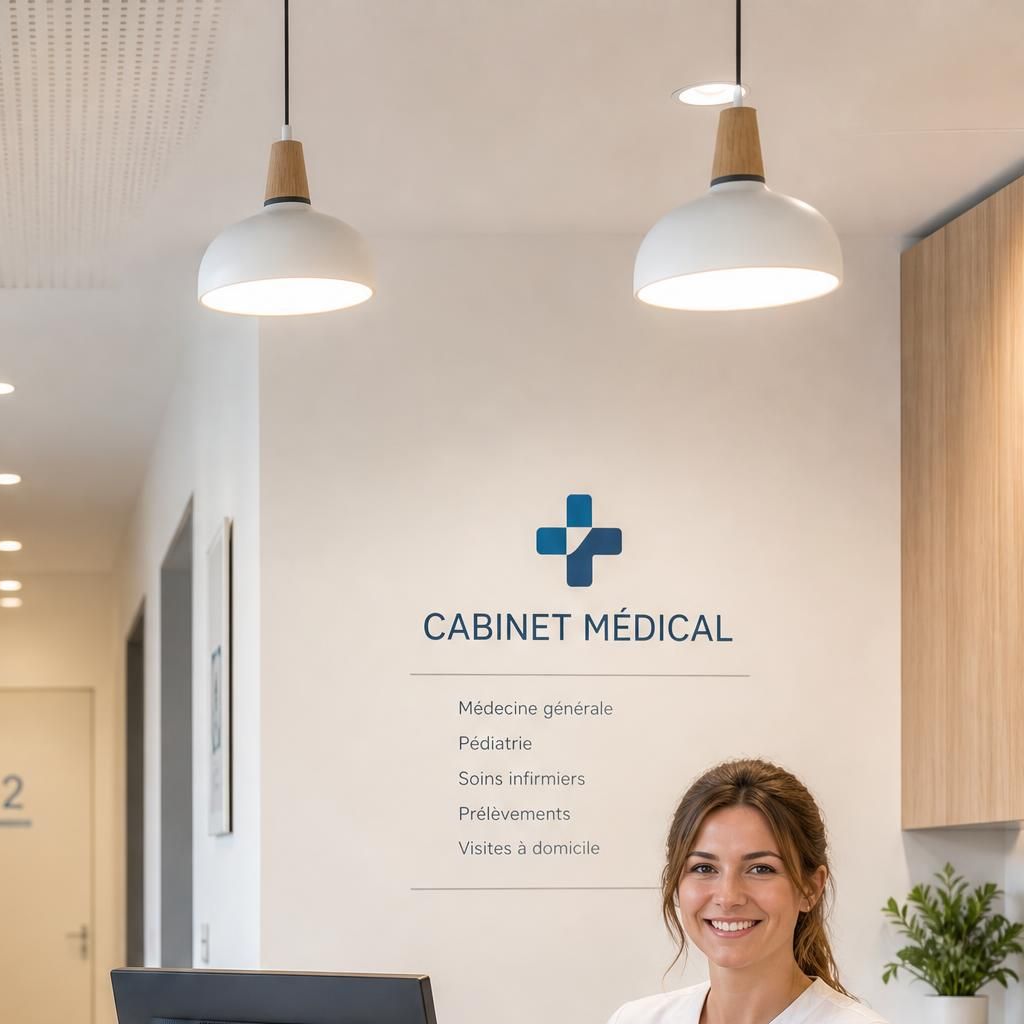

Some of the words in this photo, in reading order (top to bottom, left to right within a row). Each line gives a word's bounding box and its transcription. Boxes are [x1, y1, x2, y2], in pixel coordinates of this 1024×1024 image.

[424, 613, 571, 640] CABINET
[584, 608, 733, 642] MÉDICAL
[459, 701, 537, 715] Médecine
[544, 701, 613, 719] générale
[460, 736, 532, 750] Pédiatrie
[459, 771, 502, 785] Soins
[509, 771, 585, 785] infirmiers
[2, 774, 24, 810] 2
[460, 806, 570, 820] Prélèvements
[459, 841, 511, 855] Visites
[517, 841, 527, 856] à
[533, 841, 600, 855] domicile
